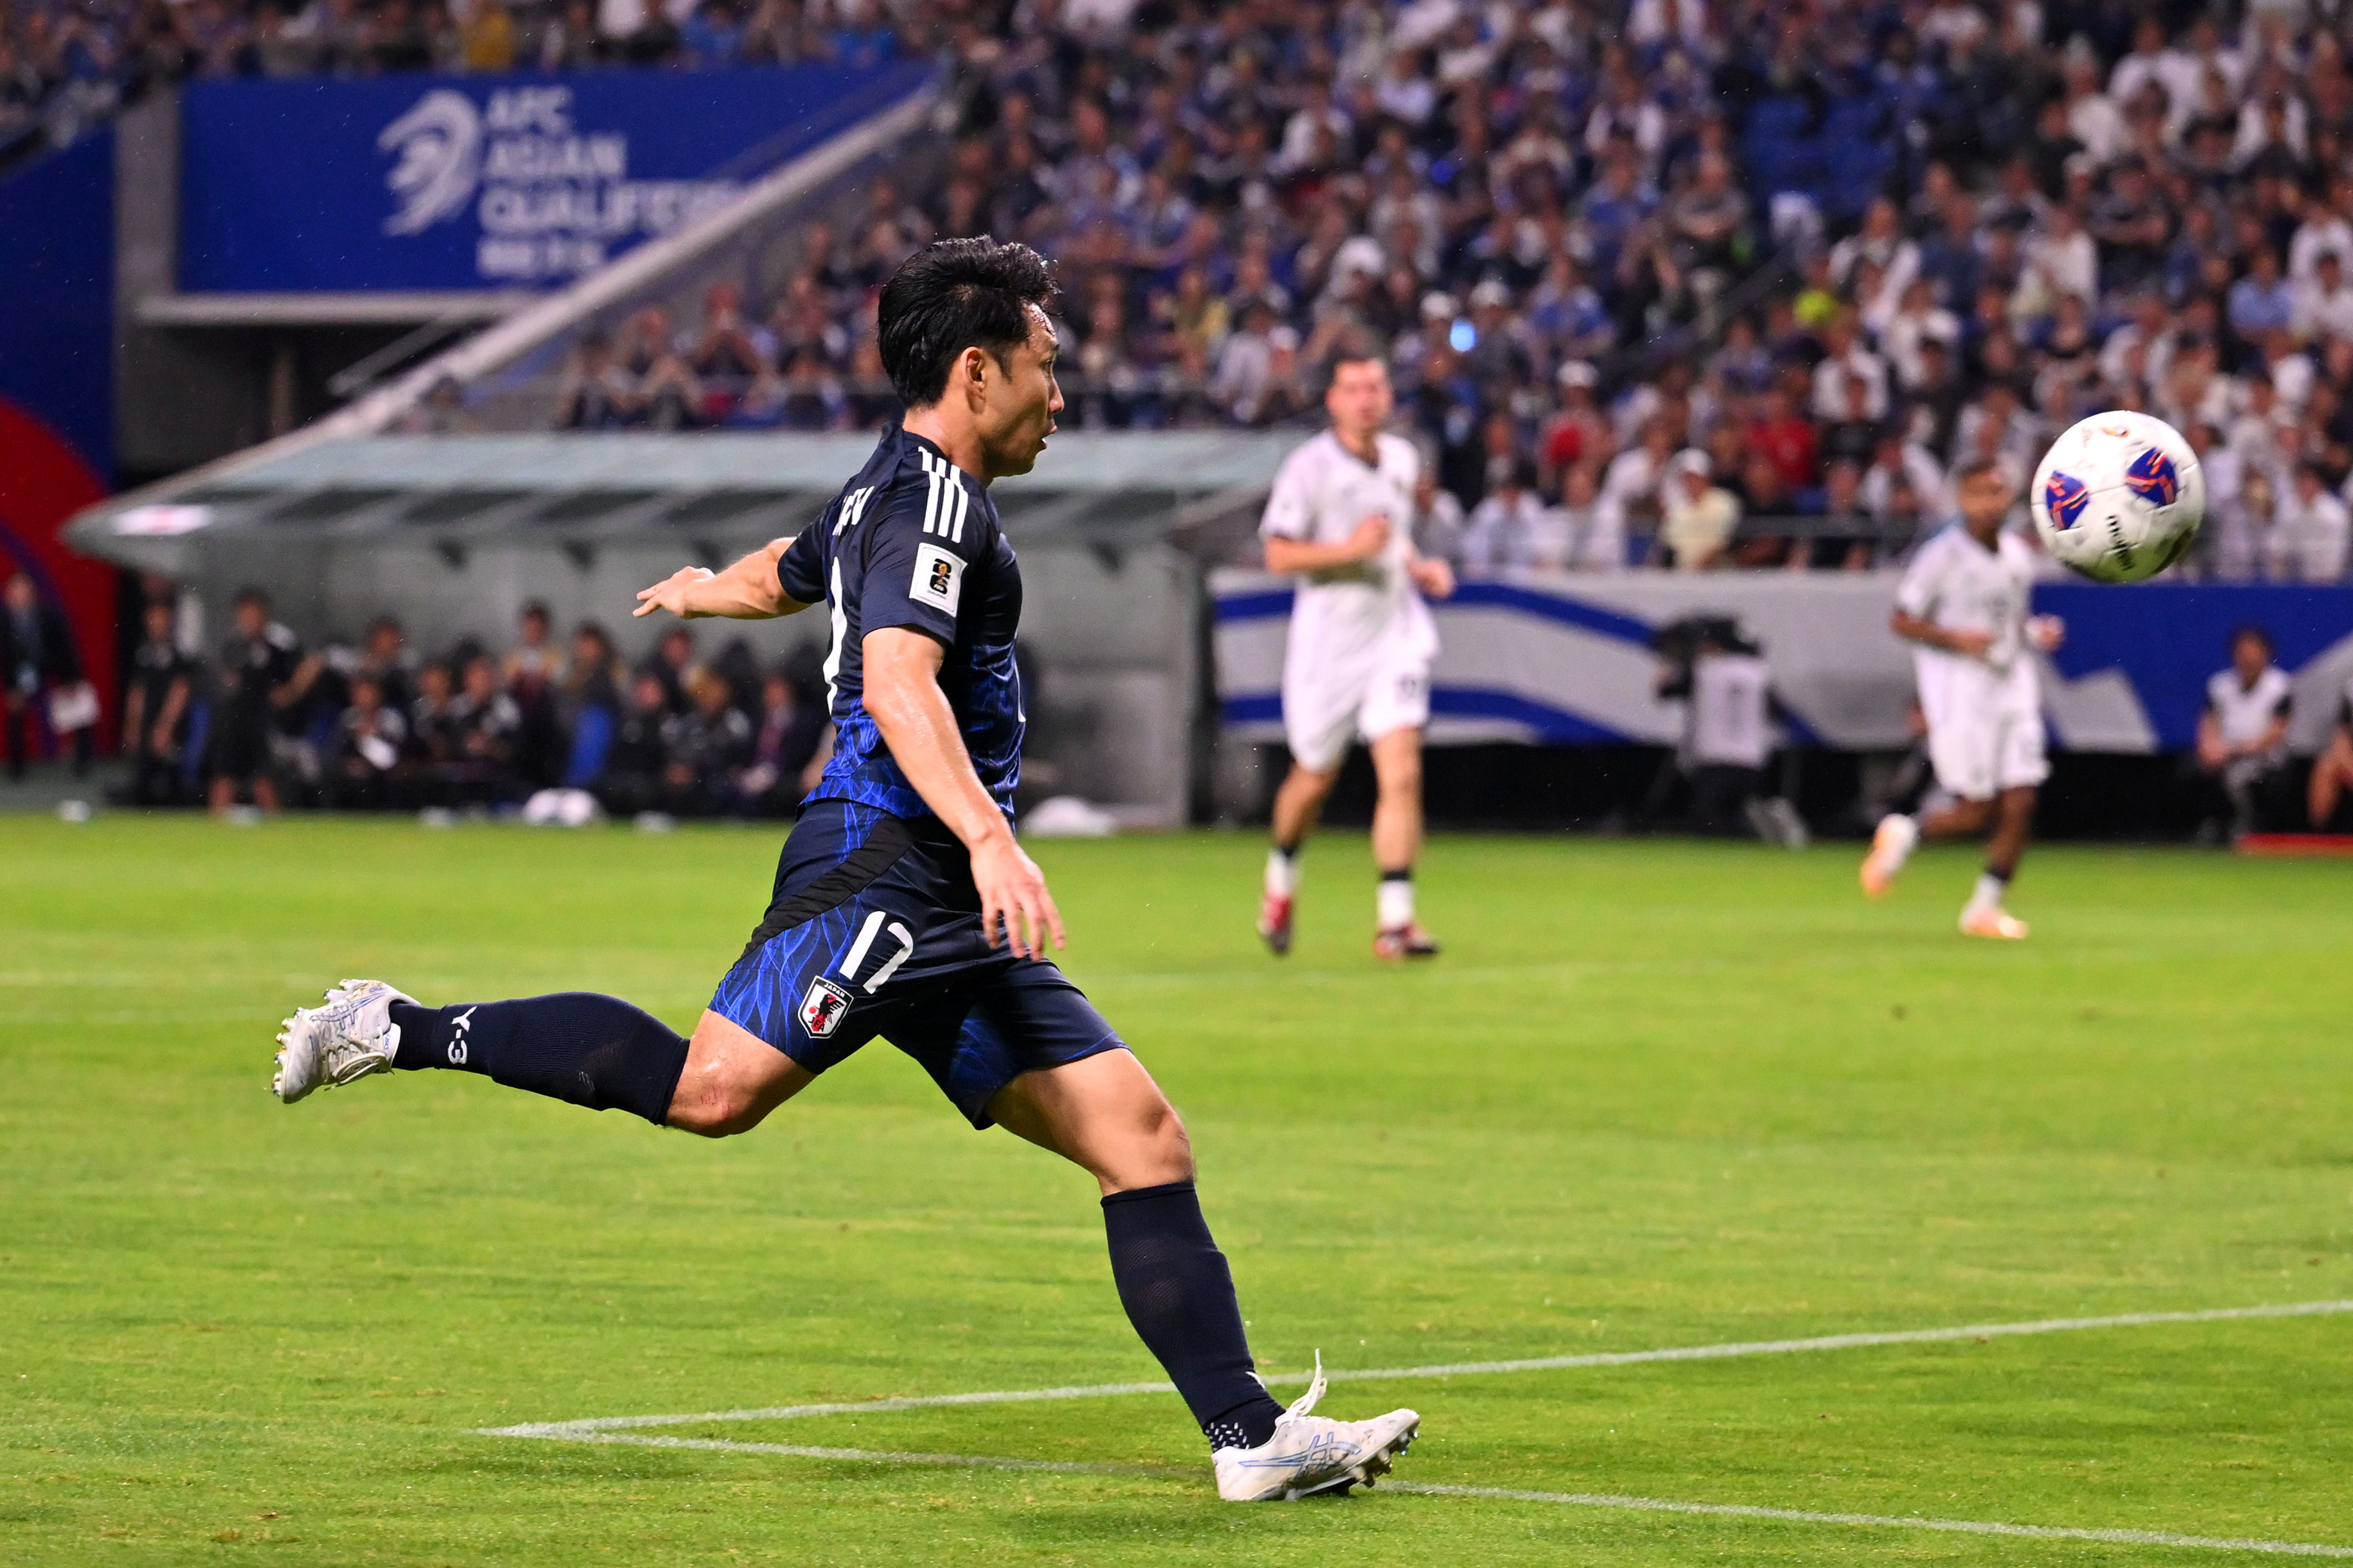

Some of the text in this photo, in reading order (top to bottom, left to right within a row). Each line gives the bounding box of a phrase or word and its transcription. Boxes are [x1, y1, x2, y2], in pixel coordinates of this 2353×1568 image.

[839, 910, 913, 995] 17
[823, 982, 845, 998] JAPAN
[448, 1005, 478, 1065] Y-3
[807, 1016, 826, 1033] JFA
